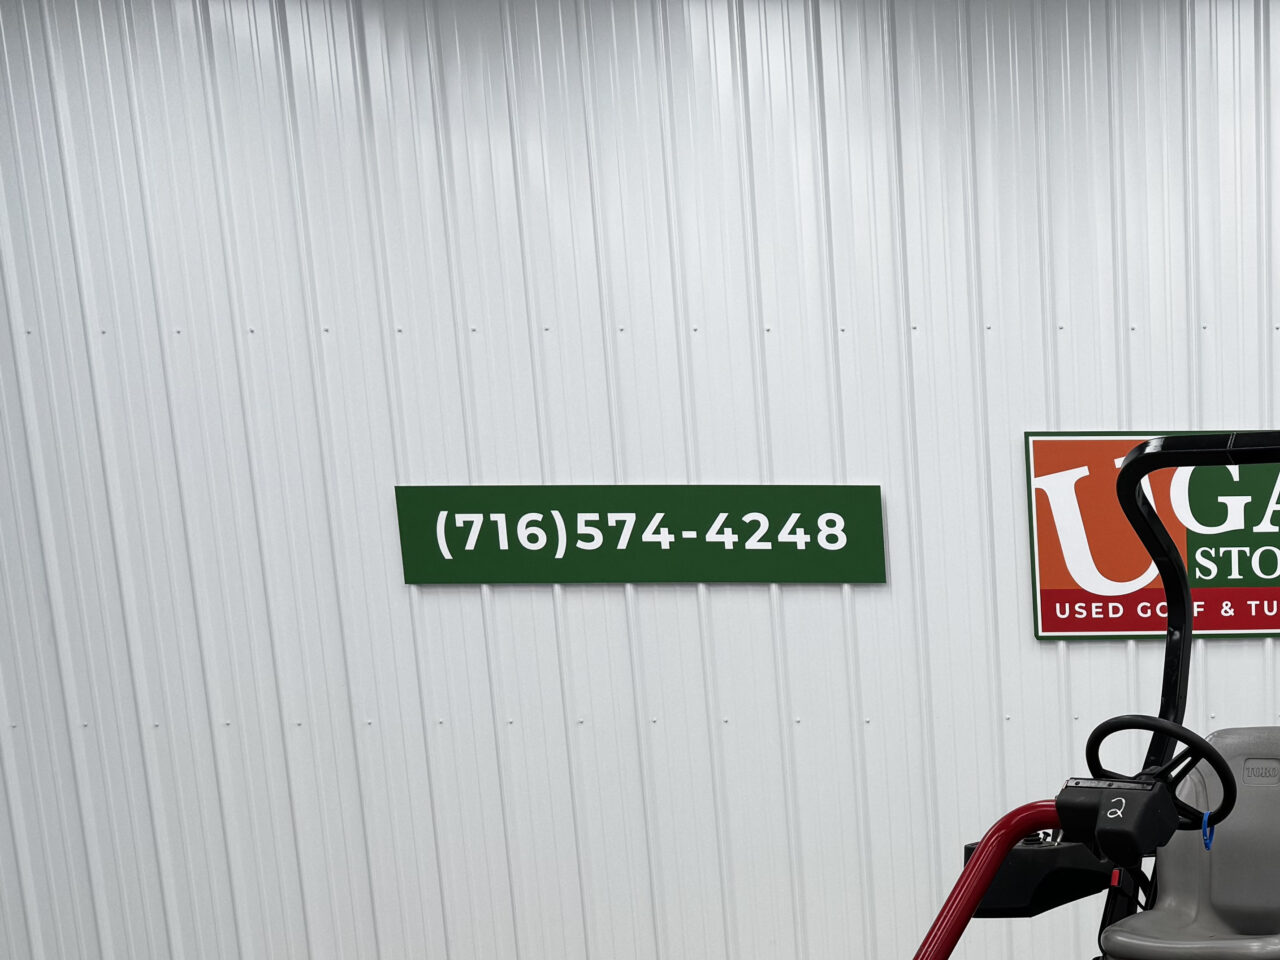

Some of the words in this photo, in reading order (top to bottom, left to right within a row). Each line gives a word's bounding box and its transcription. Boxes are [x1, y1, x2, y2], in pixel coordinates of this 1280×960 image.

[436, 510, 848, 560] (716)574-4248
[1055, 602, 1124, 619] USED
[1136, 601, 1205, 618] GOF
[1220, 601, 1235, 617] &
[1246, 767, 1279, 778] TORO
[1107, 797, 1126, 818] 2
